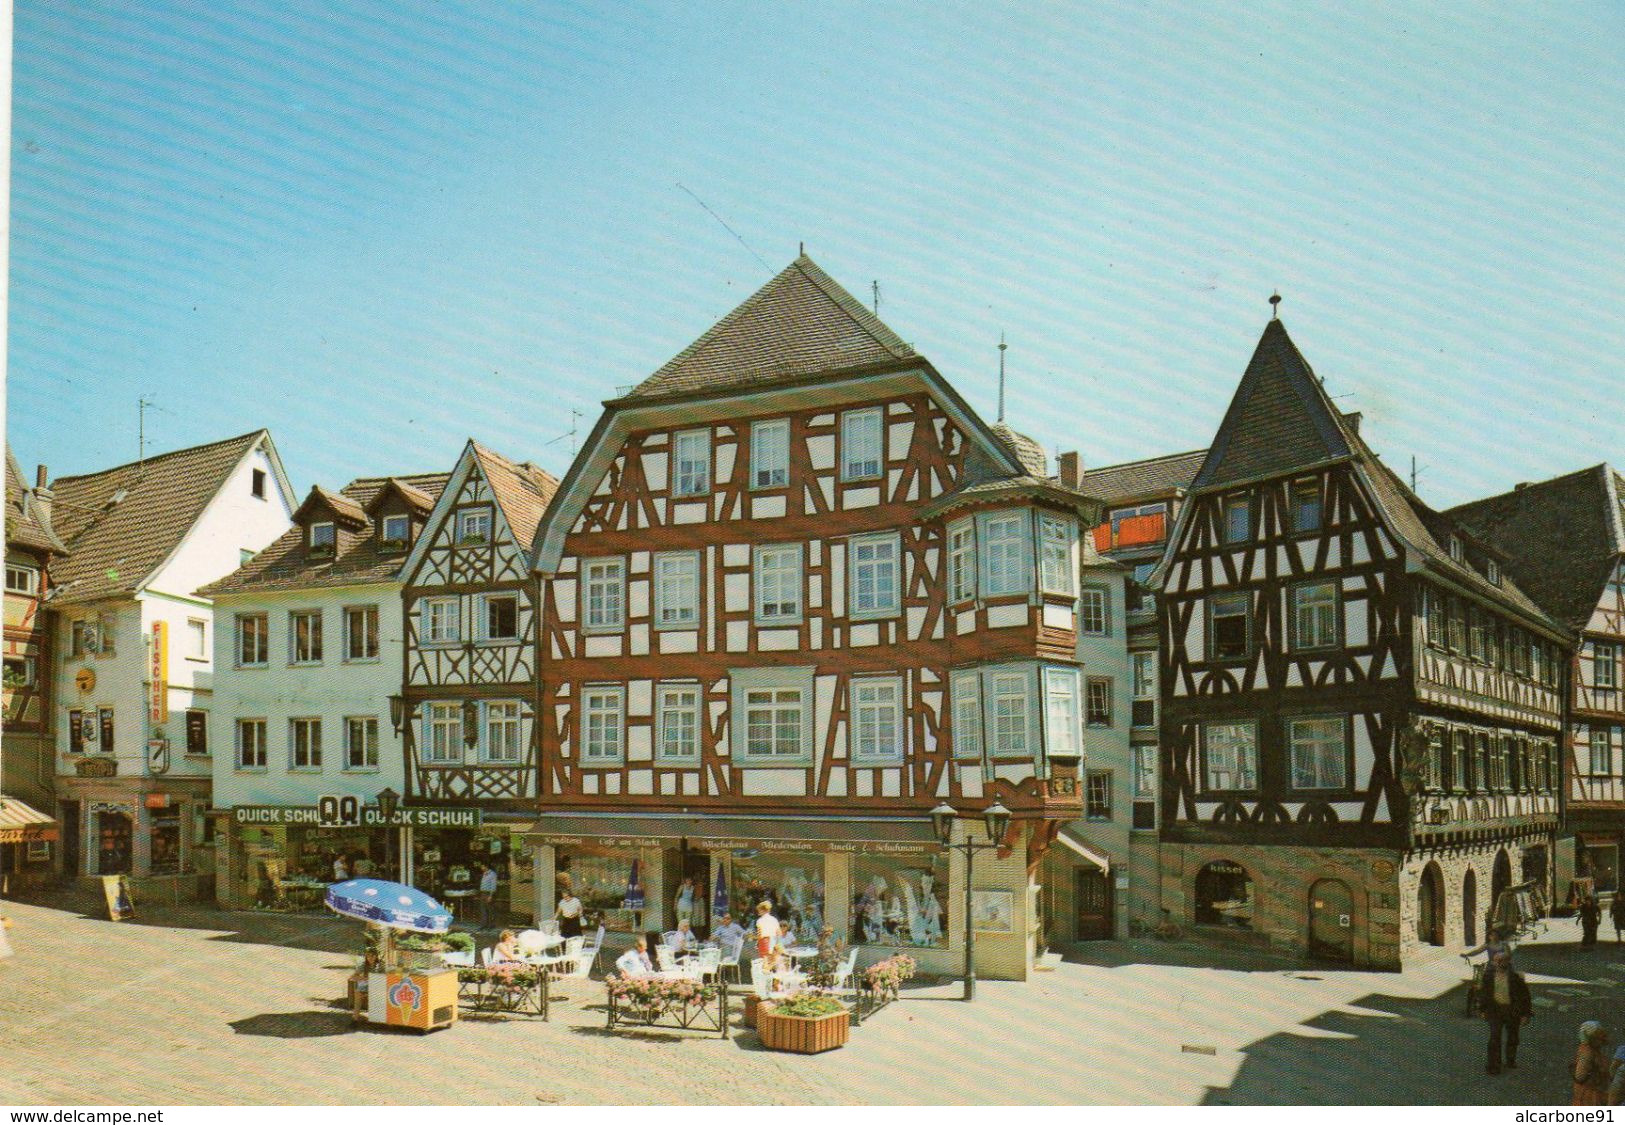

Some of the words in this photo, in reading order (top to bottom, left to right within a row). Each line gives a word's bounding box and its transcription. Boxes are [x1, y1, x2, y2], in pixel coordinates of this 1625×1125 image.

[153, 623, 161, 721] FISCHER
[237, 808, 280, 824] QUICK
[366, 810, 412, 825] QUCK
[418, 811, 474, 825] SCHUH
